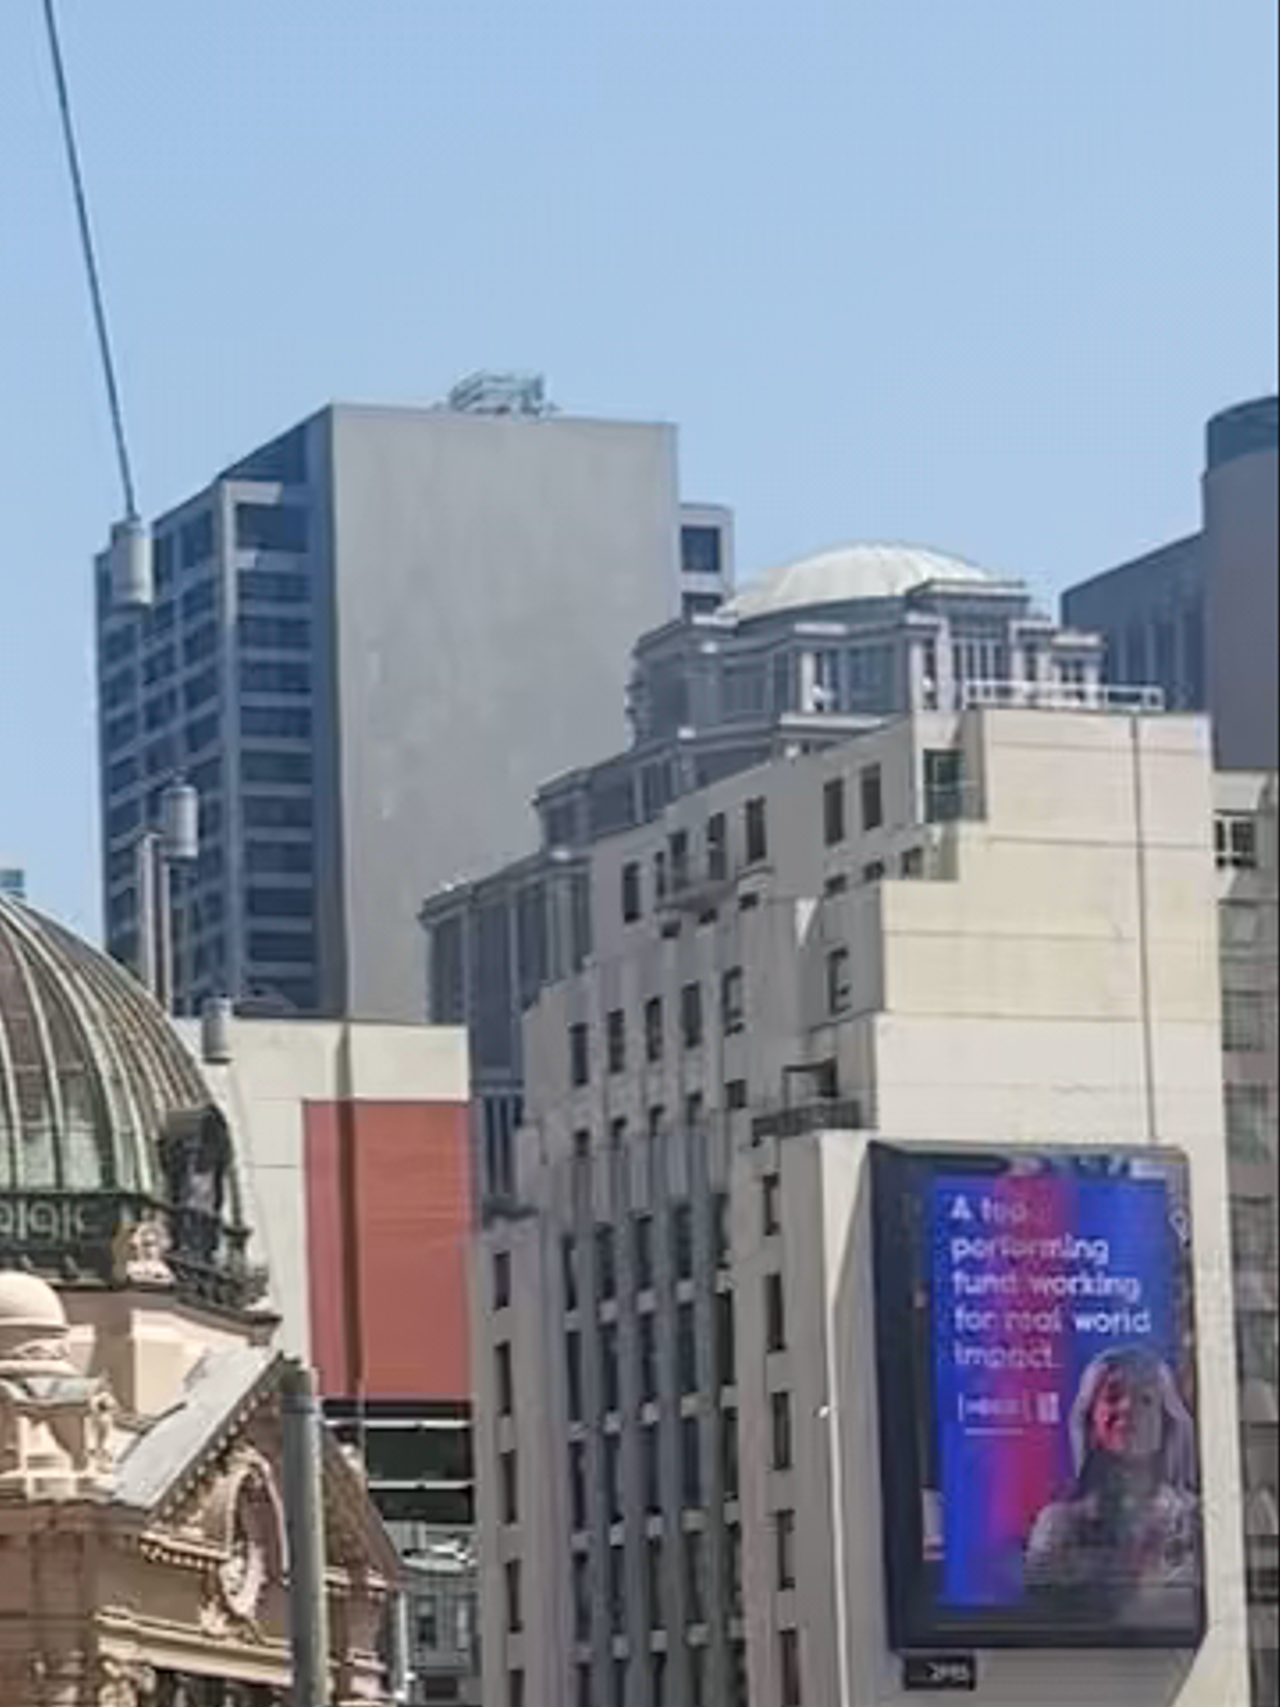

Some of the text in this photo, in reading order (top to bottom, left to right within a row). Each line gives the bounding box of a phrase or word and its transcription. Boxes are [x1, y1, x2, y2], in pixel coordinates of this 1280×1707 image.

[950, 1194, 972, 1220] A
[951, 1232, 1110, 1265] performing
[952, 1270, 1141, 1302] fund working
[954, 1304, 995, 1332] for
[1074, 1305, 1151, 1332] world
